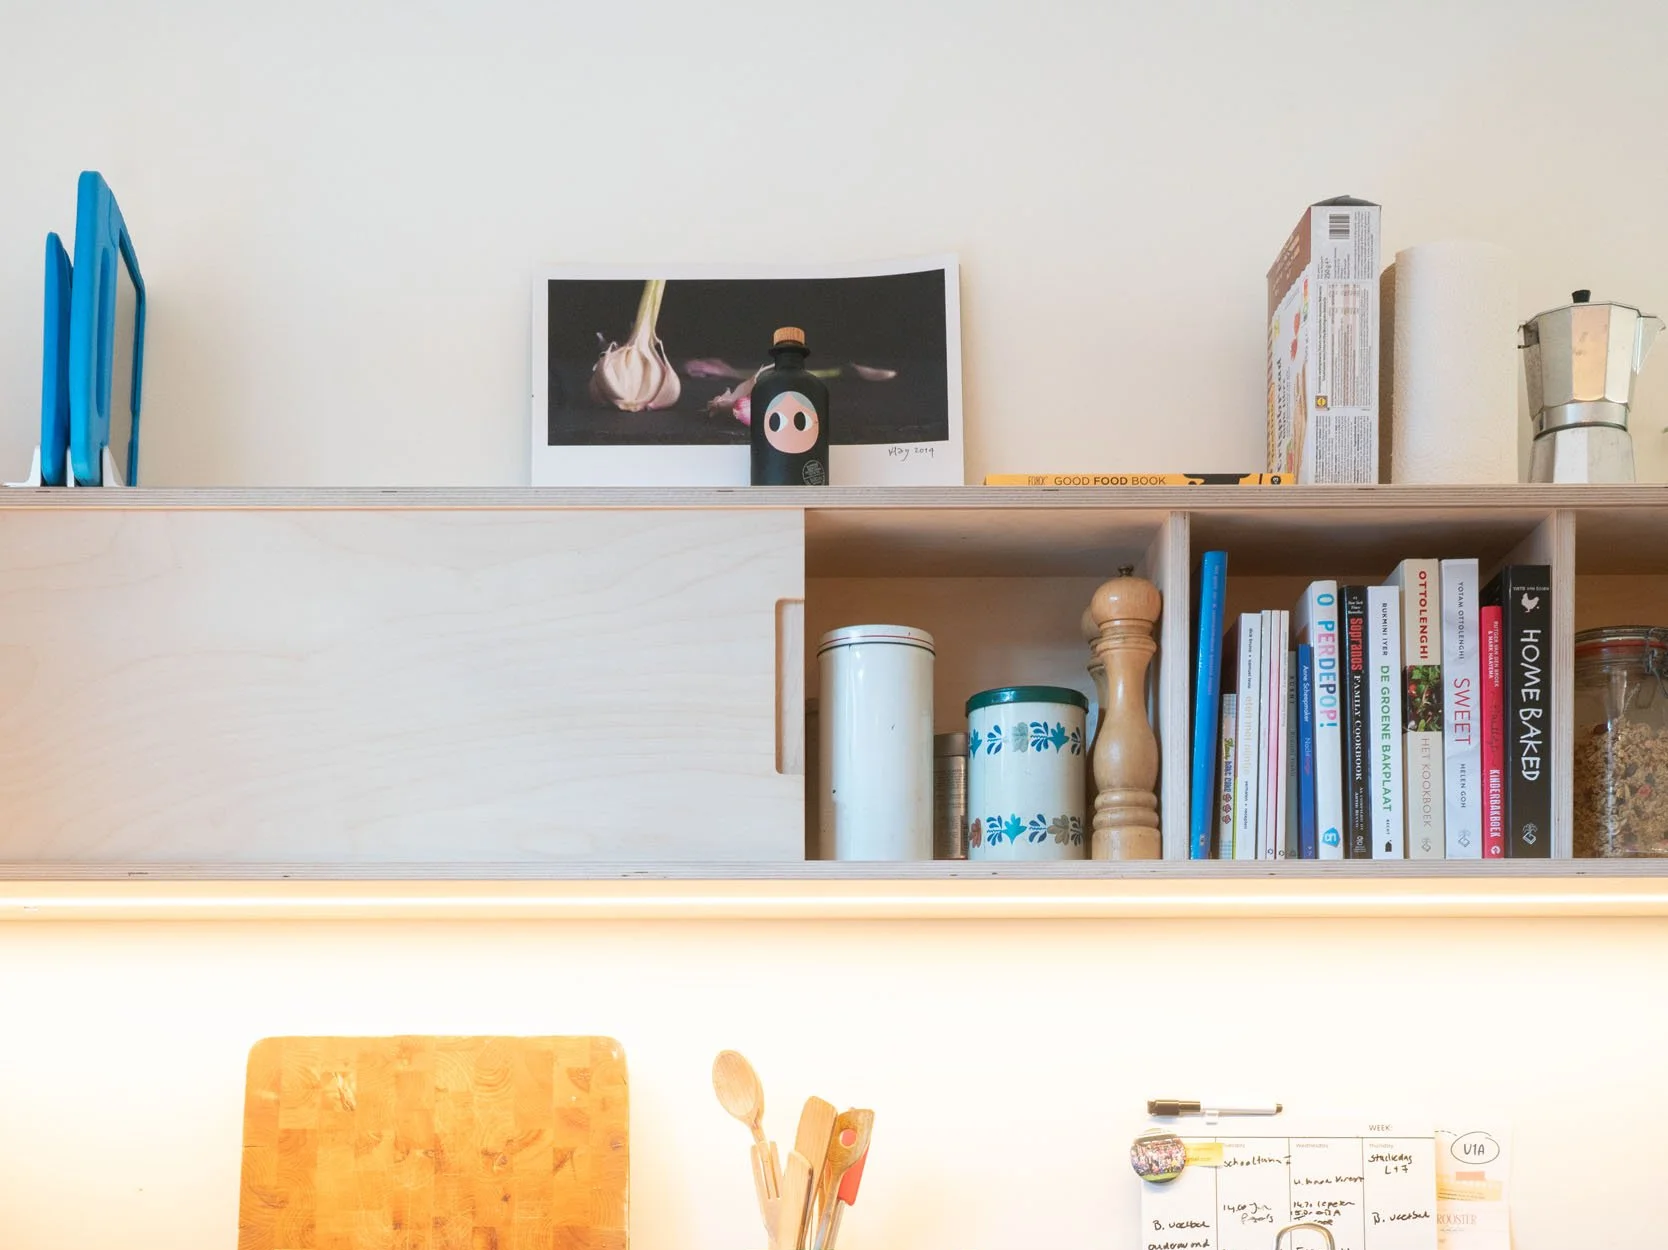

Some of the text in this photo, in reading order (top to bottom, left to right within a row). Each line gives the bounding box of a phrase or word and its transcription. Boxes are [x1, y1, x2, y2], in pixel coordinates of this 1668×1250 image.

[1054, 476, 1090, 486] GOOD
[1093, 476, 1128, 486] FOOD
[1131, 476, 1166, 486] BOOK
[1348, 617, 1363, 671] Sopranos
[1418, 570, 1429, 660] OTTOLENGHI
[1317, 593, 1337, 728] O PERDEPOP!
[1519, 629, 1542, 782] HOME BAKED
[1353, 675, 1363, 781] FAMILY COOKBOOK
[1380, 665, 1392, 812] DE GROENE BAKPLAAT
[1453, 678, 1471, 746] SWEET
[1421, 738, 1432, 828] HET KOOKBOEK
[1459, 790, 1467, 808] GOH
[1489, 769, 1501, 837] KINDERBAKBOEK
